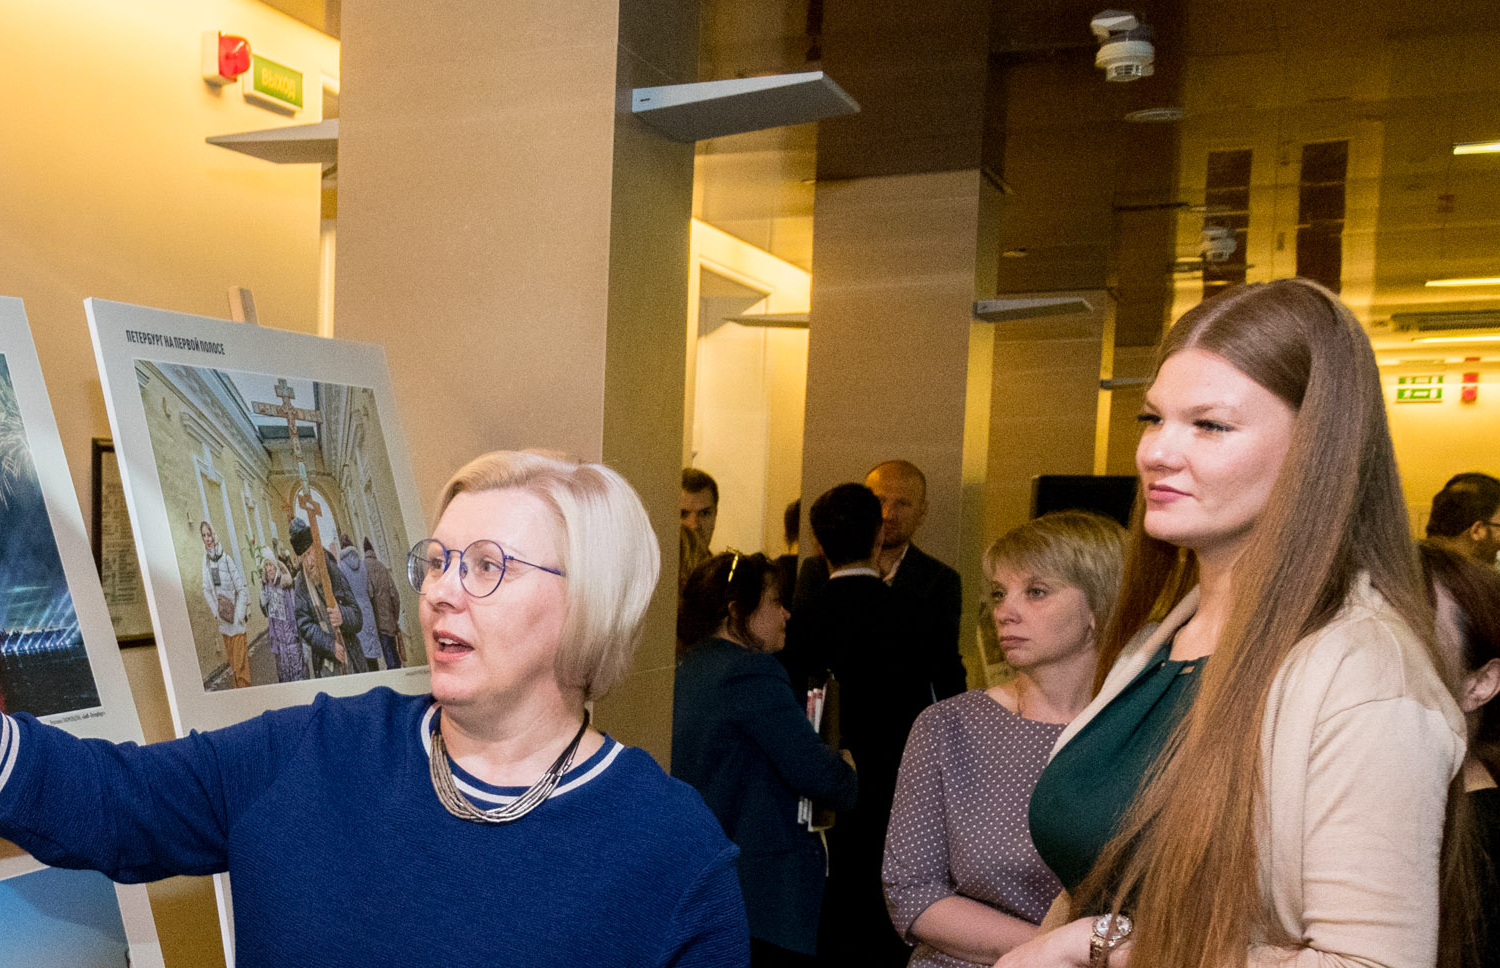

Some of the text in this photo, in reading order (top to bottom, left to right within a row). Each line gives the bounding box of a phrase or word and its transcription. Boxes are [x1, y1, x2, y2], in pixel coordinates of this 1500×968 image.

[261, 67, 296, 101] ВЫХОД
[125, 329, 225, 355] ПЕТЕРБУРГ НА ПЕРВОЙ ПОЛОСЕ
